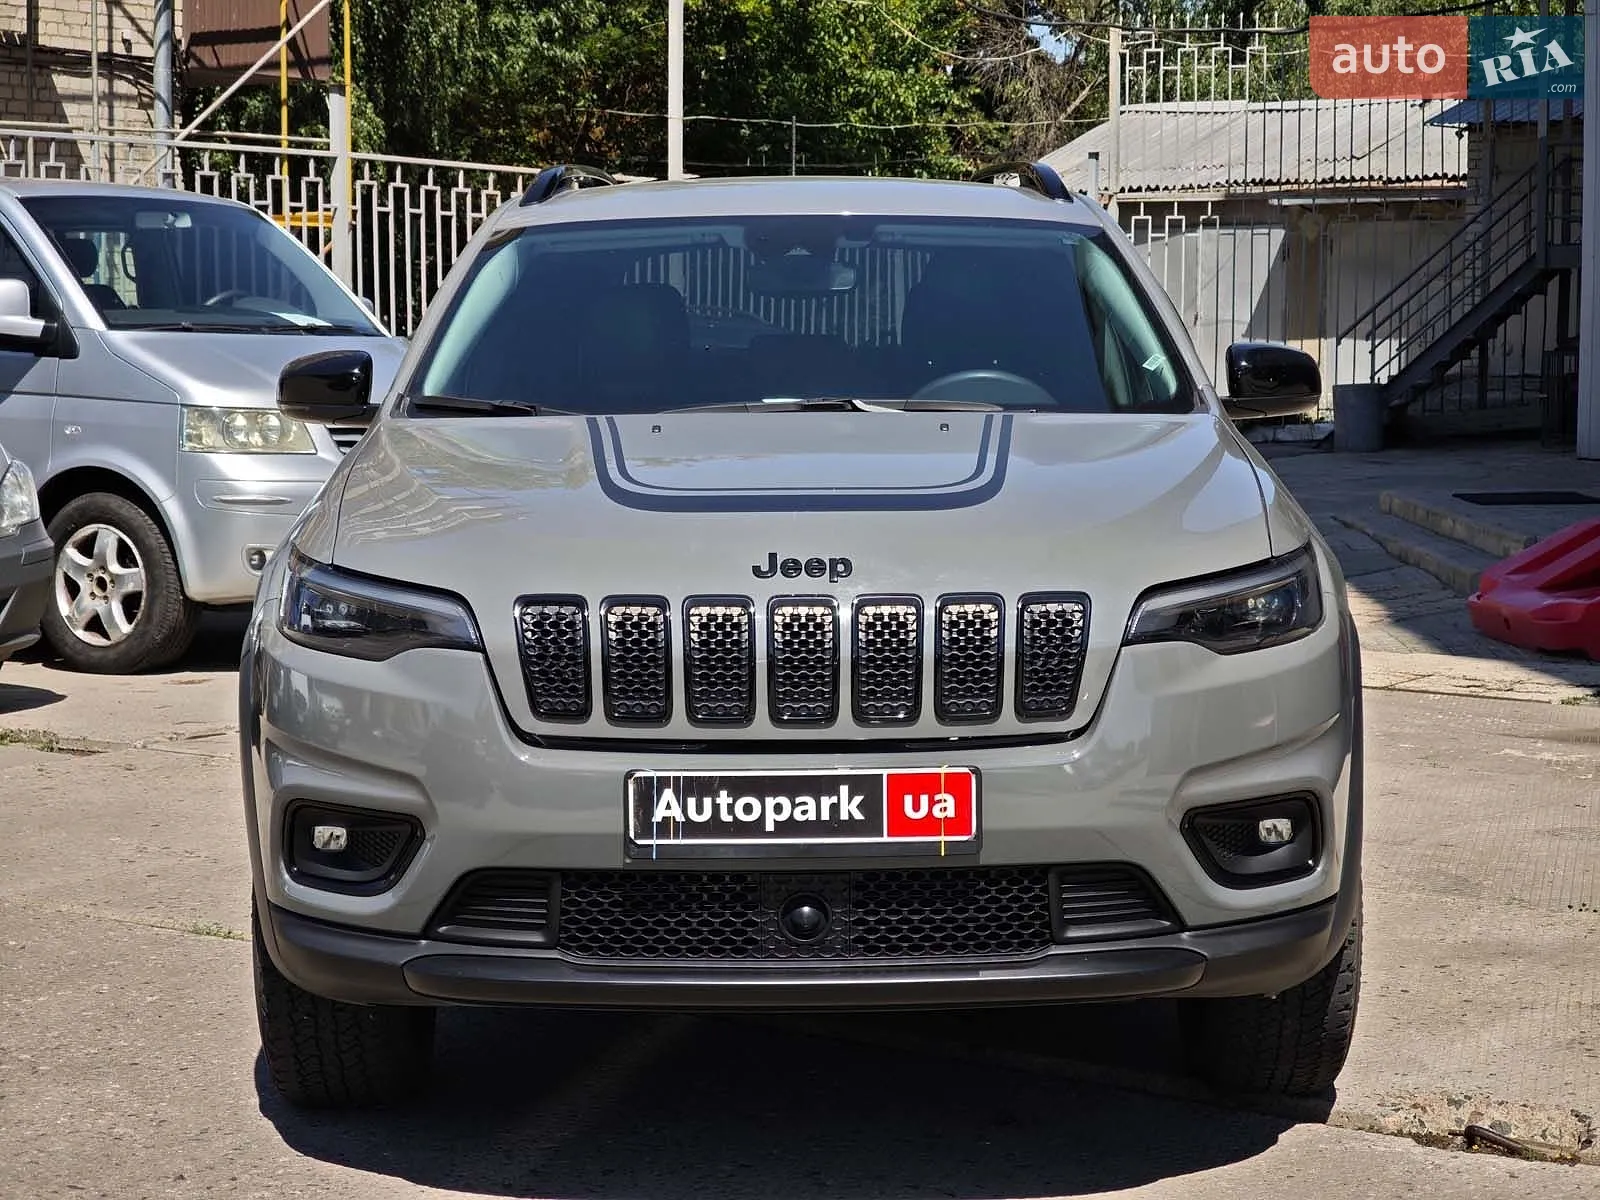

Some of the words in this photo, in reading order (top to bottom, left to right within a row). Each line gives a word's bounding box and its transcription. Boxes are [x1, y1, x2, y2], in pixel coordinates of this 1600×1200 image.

[752, 552, 853, 583] Jeep
[651, 785, 865, 832] Autopark
[903, 792, 956, 819] ua
